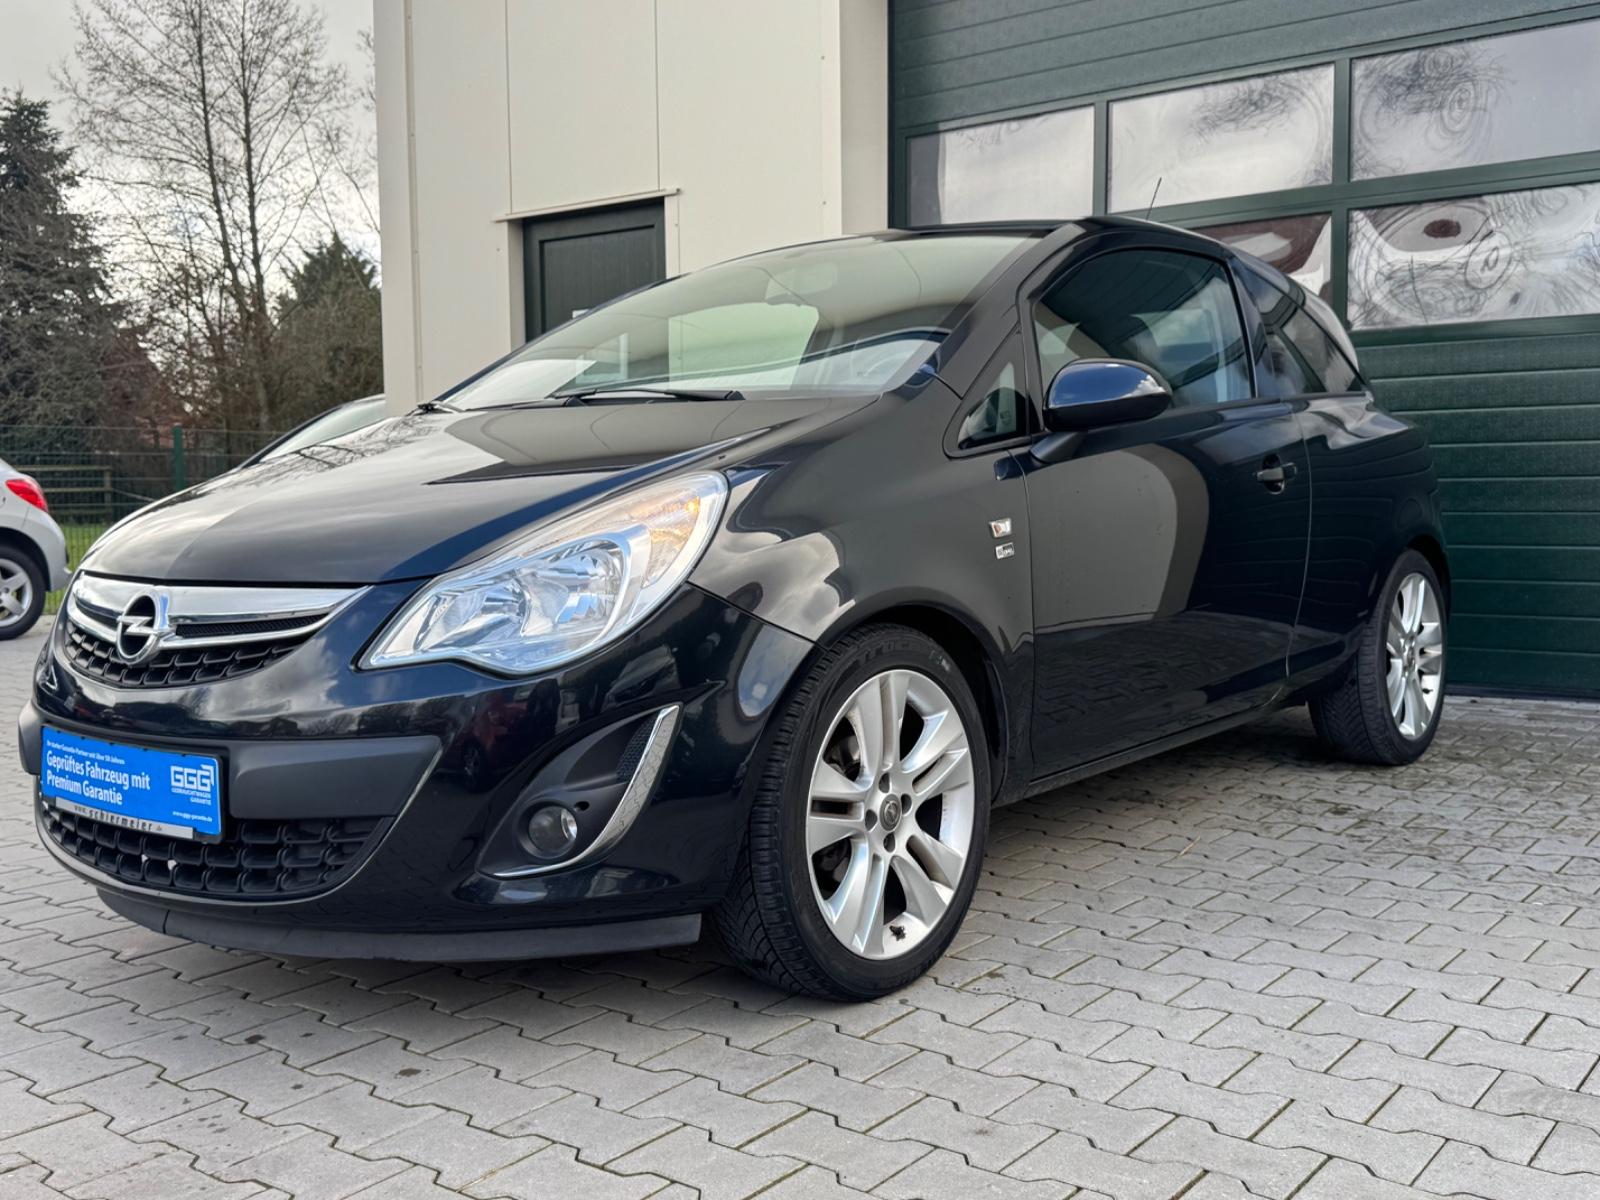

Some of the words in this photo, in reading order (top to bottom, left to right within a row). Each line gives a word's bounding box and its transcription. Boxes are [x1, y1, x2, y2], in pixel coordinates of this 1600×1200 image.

[46, 750, 85, 776] Geprüftes
[85, 761, 130, 791] Fahrzeug
[131, 772, 151, 791] mit
[46, 769, 82, 796] Premium
[83, 780, 123, 806] Garantie
[170, 765, 213, 793] GGG
